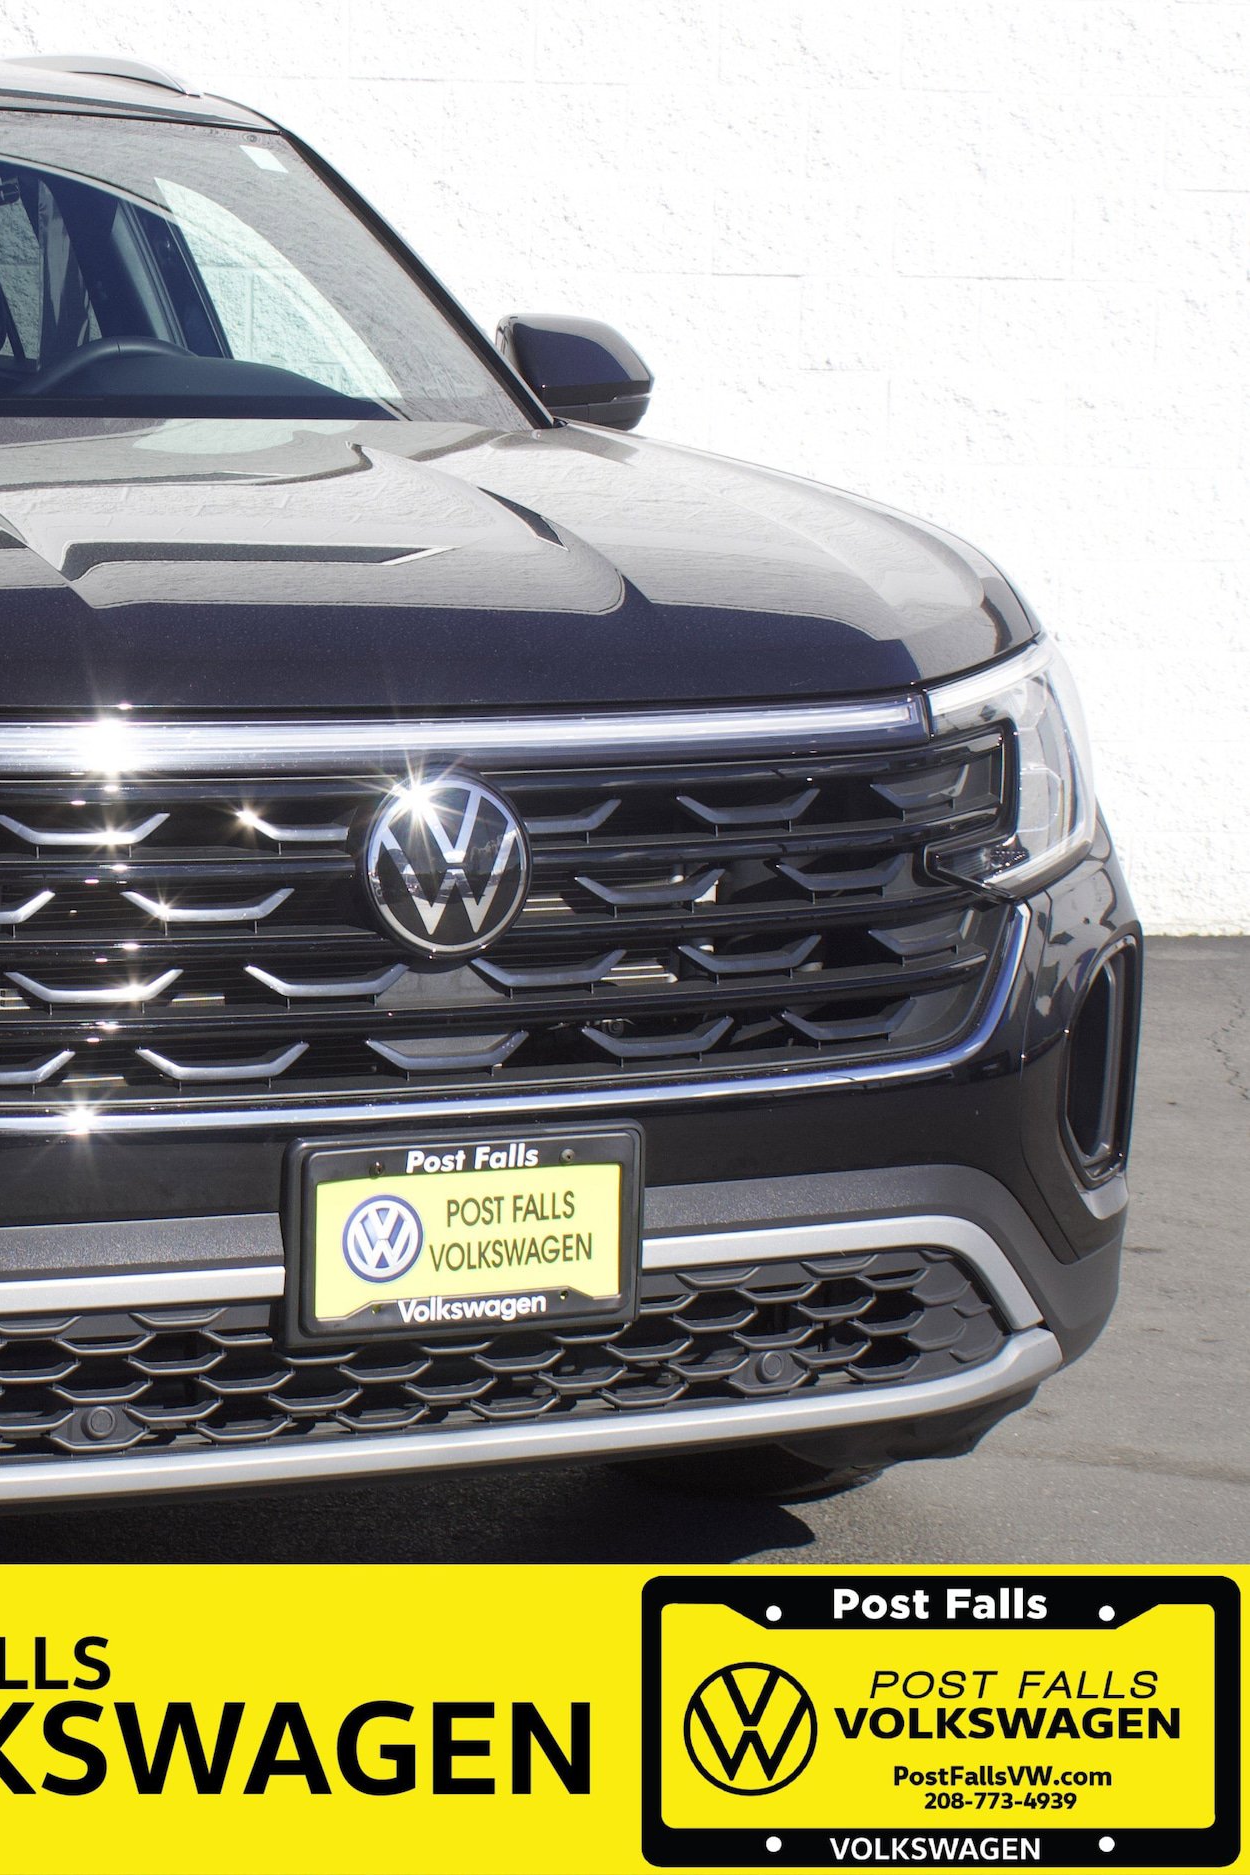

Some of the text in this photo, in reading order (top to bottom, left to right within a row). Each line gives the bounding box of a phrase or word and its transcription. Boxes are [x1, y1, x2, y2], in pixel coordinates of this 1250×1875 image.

[367, 779, 527, 953] VW
[405, 1142, 540, 1174] Post Falls
[446, 1190, 576, 1228] POST FALLS
[342, 1194, 424, 1284] VW
[429, 1232, 593, 1273] VOLKSWAGEN
[398, 1294, 547, 1324] Volkswagen
